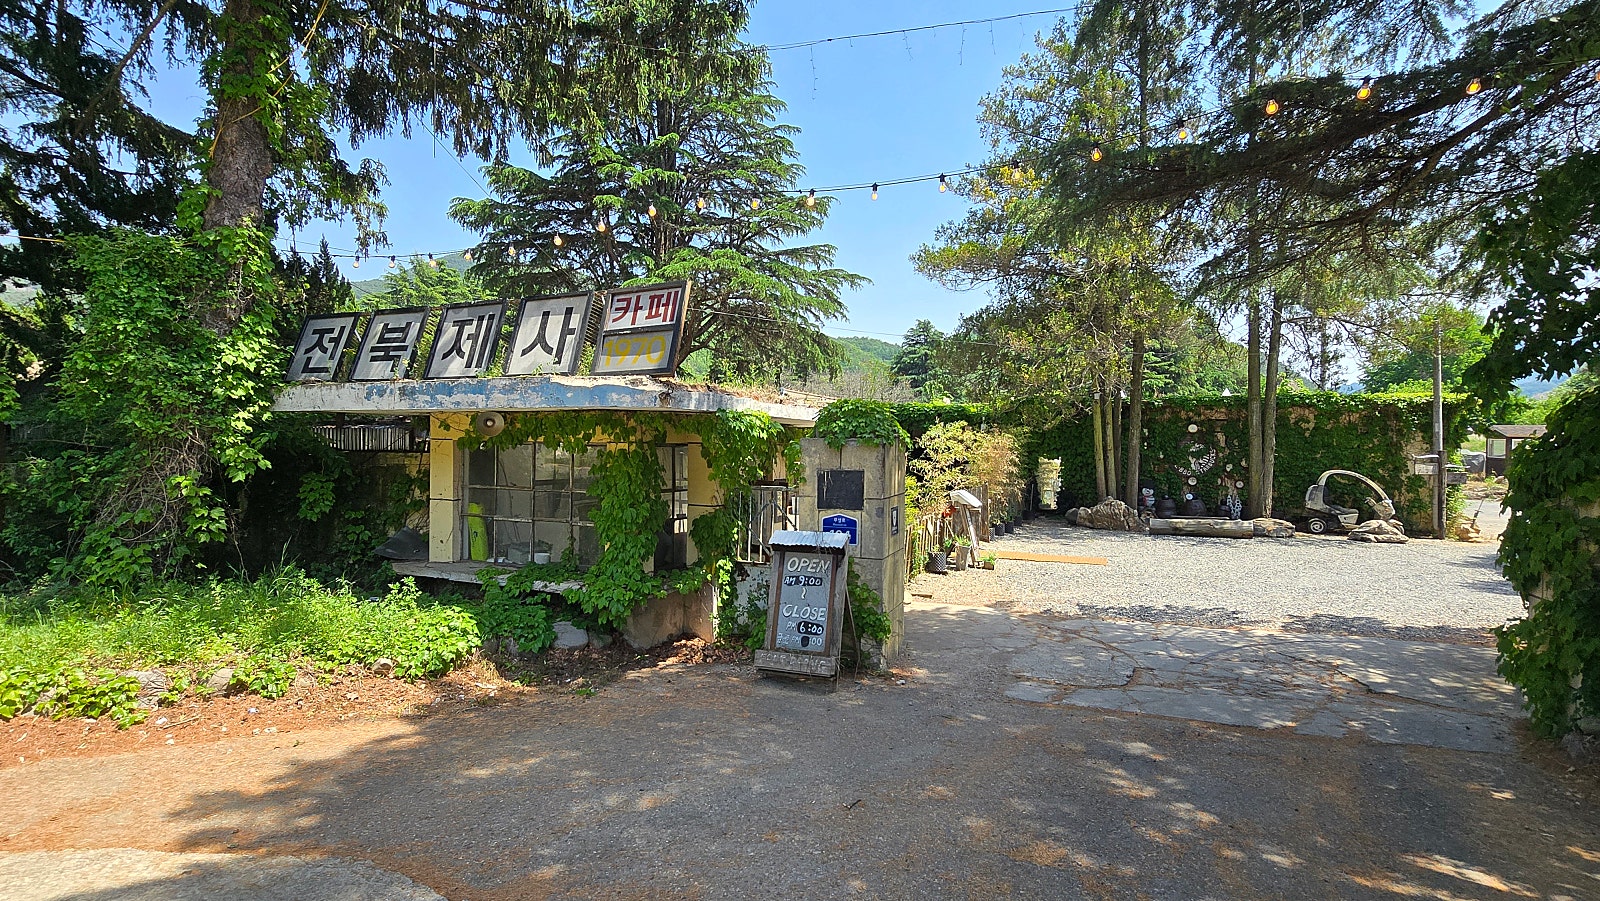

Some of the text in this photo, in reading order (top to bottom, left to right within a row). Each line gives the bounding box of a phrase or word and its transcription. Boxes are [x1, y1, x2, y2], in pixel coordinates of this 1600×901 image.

[611, 290, 680, 326] 카페
[302, 306, 577, 376] 전북제사
[603, 335, 667, 368] 1970
[787, 557, 830, 573] OPEN
[784, 575, 821, 586] AM 9:00
[782, 604, 827, 620] CLOSE
[786, 621, 823, 634] PM 6:00
